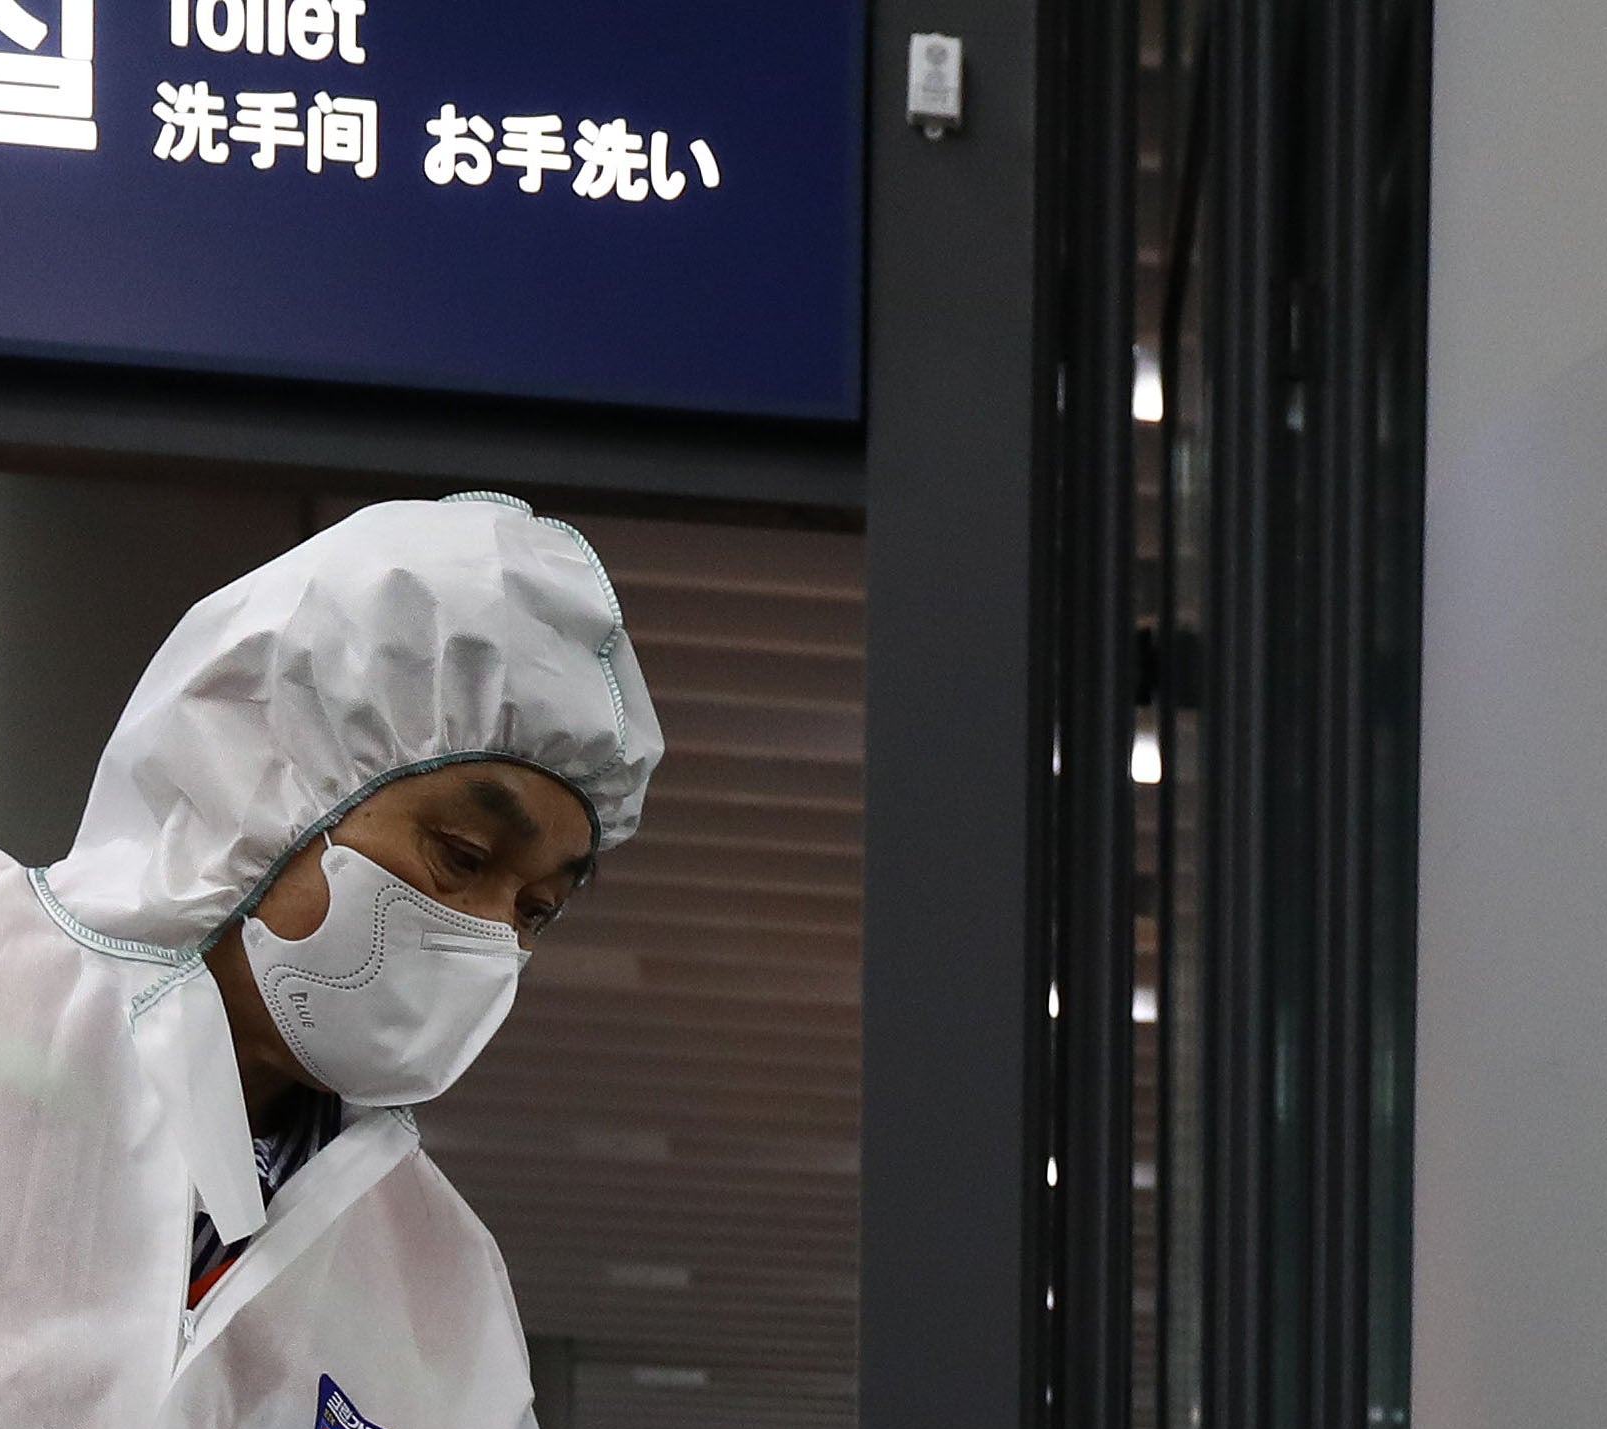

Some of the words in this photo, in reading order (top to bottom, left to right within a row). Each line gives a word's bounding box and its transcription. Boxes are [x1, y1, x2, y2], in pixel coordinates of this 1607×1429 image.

[152, 80, 378, 179] 洗手间
[424, 103, 720, 202] お手洗い
